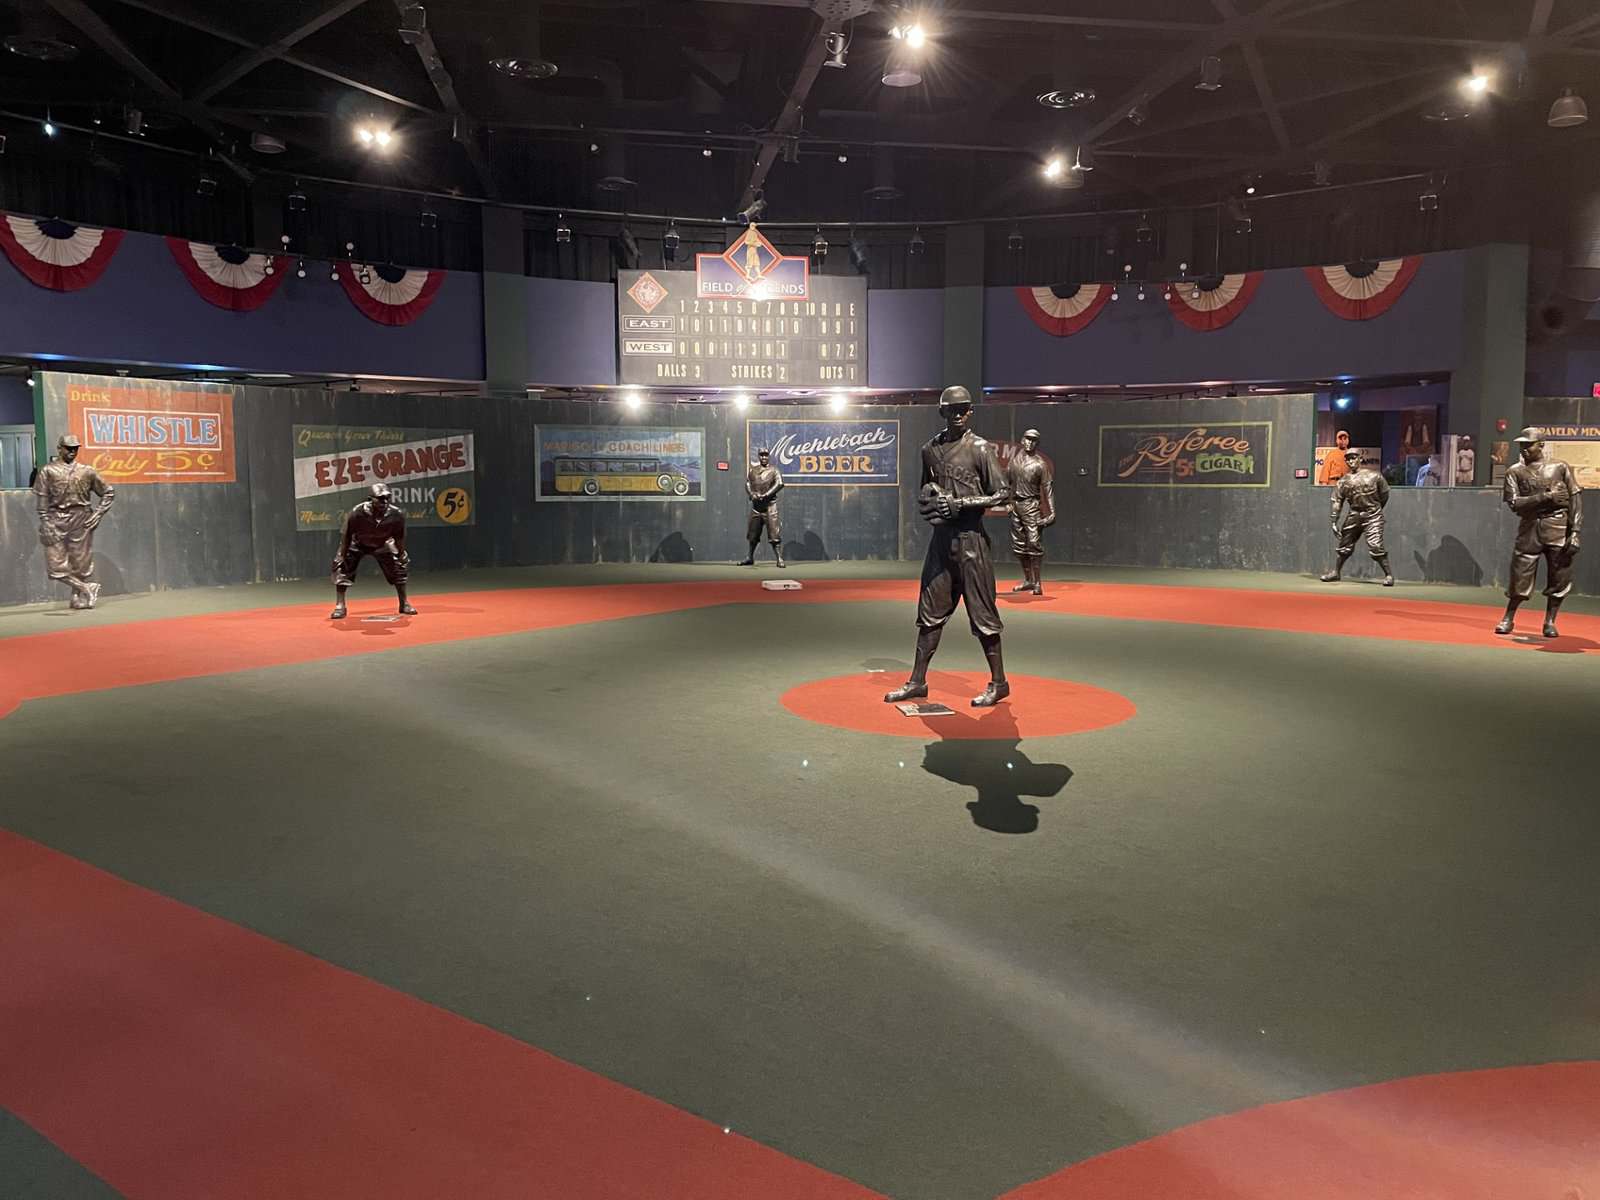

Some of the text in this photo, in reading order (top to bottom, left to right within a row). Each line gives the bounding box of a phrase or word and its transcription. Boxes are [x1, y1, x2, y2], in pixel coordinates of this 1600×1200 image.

[702, 281, 733, 293] FIELD
[629, 319, 669, 328] EAST
[630, 343, 669, 351] WEST
[657, 363, 700, 378] BALLS 3
[731, 365, 785, 379] STRIKES 2
[820, 366, 843, 379] OUTS
[71, 389, 111, 403] Drink
[88, 413, 218, 446] WHISTLE
[608, 441, 649, 453] COACH
[769, 427, 896, 465] Muehlebach
[1117, 427, 1250, 478] Referee
[92, 451, 149, 477] Only
[314, 442, 466, 488] EZE-ORANGE
[799, 455, 874, 473] BEER
[1200, 457, 1245, 473] CIGAR
[391, 487, 465, 519] RINK 5¢
